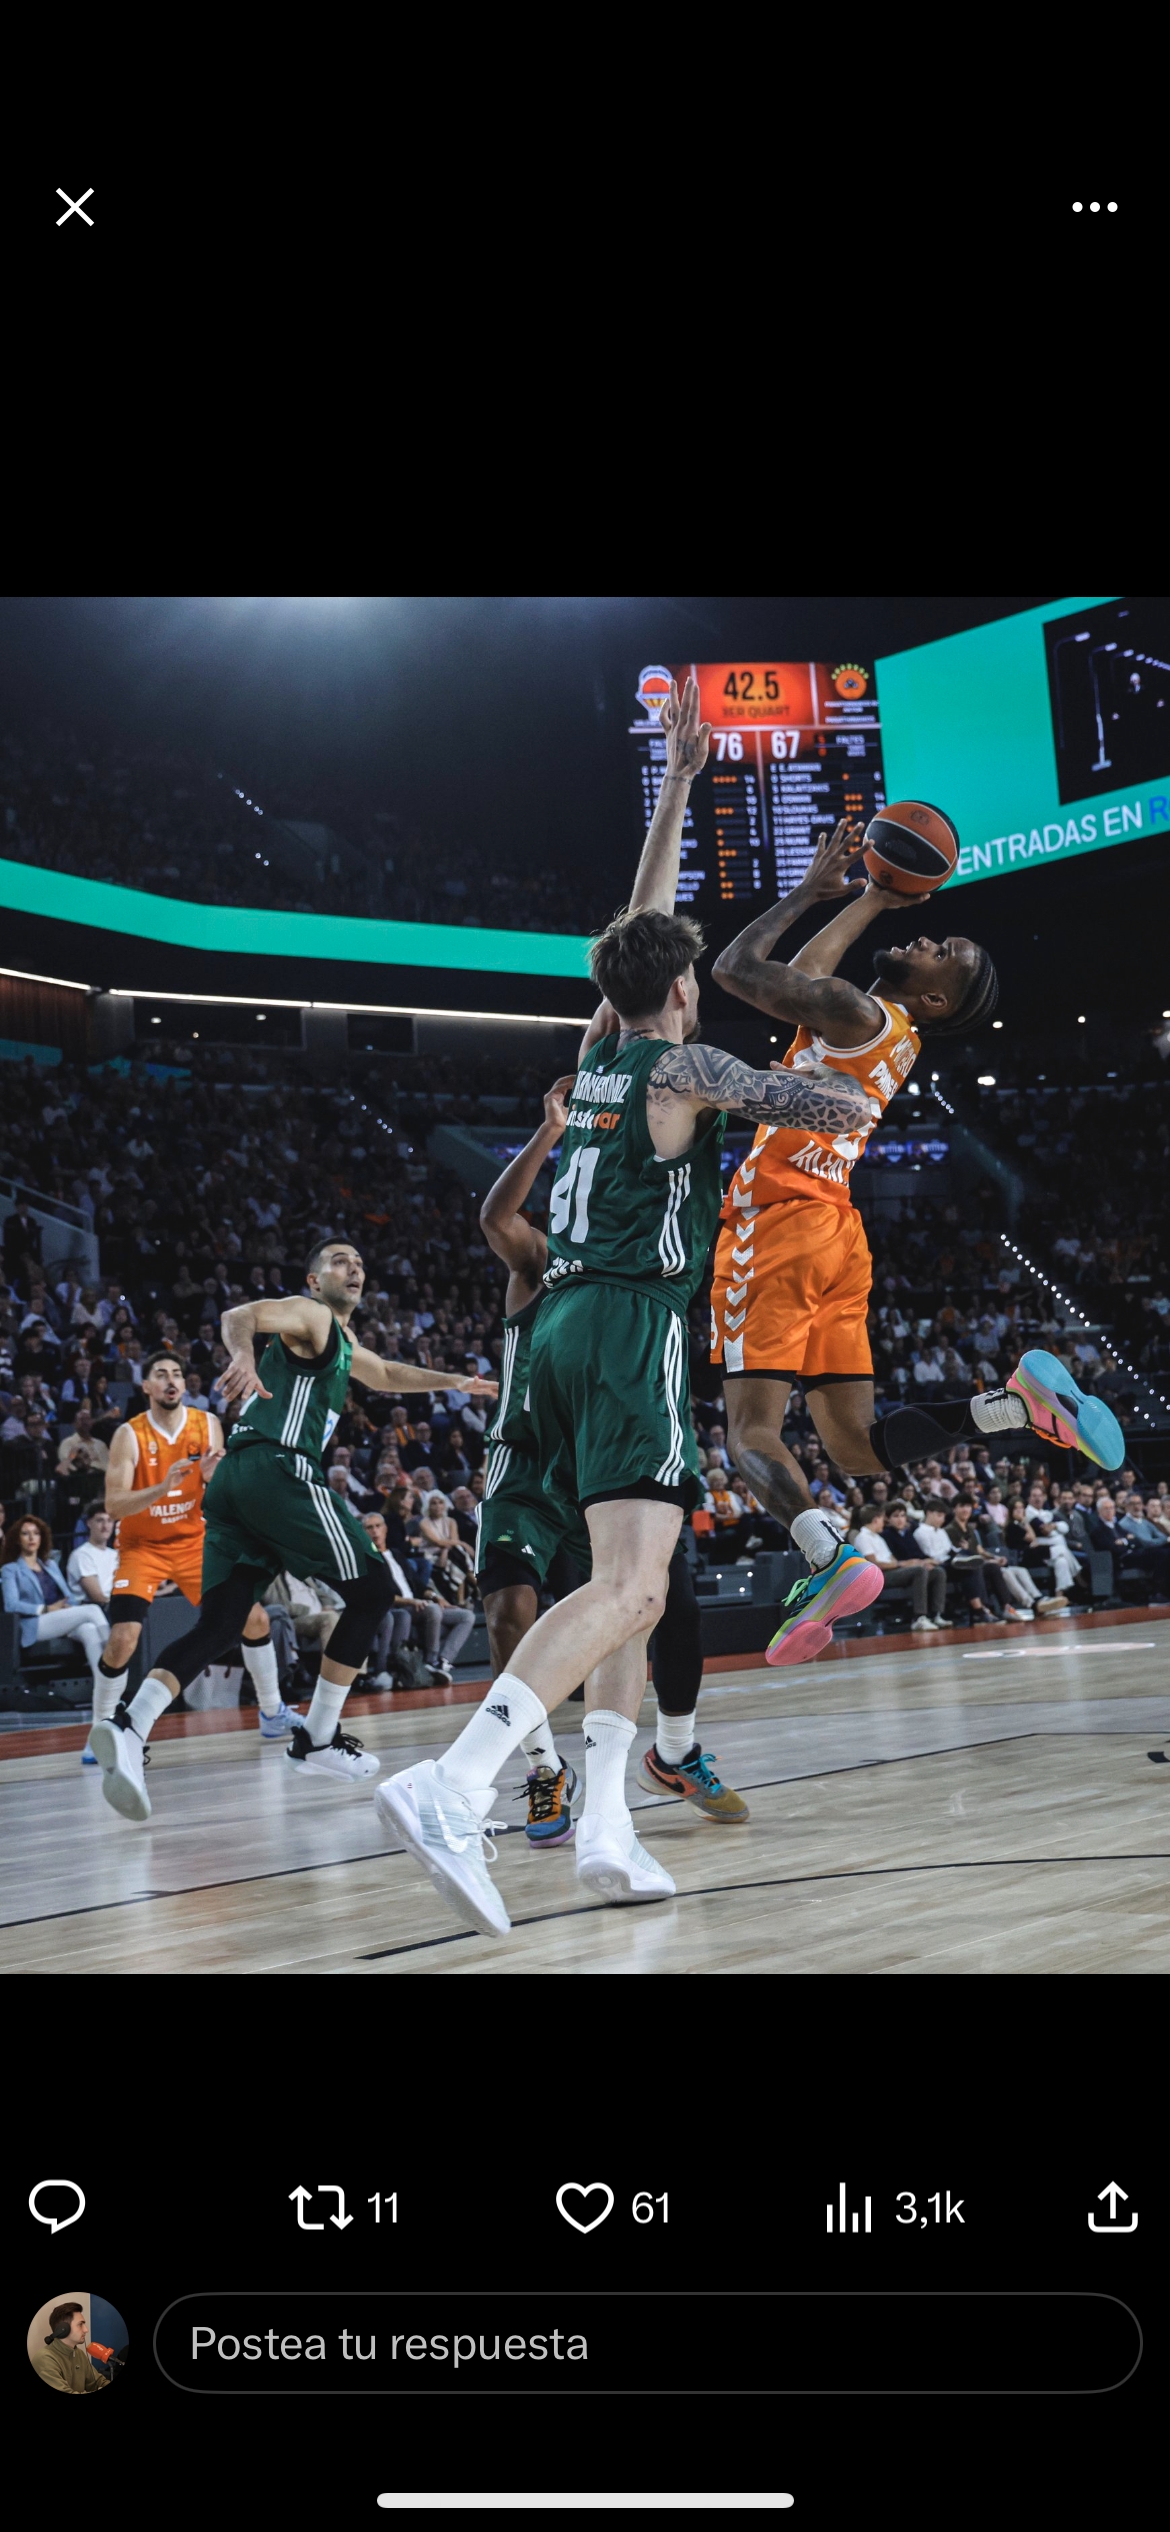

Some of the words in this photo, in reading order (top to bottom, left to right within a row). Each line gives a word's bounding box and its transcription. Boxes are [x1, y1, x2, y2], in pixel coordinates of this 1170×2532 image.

[723, 671, 780, 702] 42.5
[711, 732, 744, 762] 76
[771, 730, 800, 760] 67
[956, 812, 1098, 876] ENTRADAS
[1103, 801, 1143, 837] EN
[485, 1707, 512, 1727] adidas
